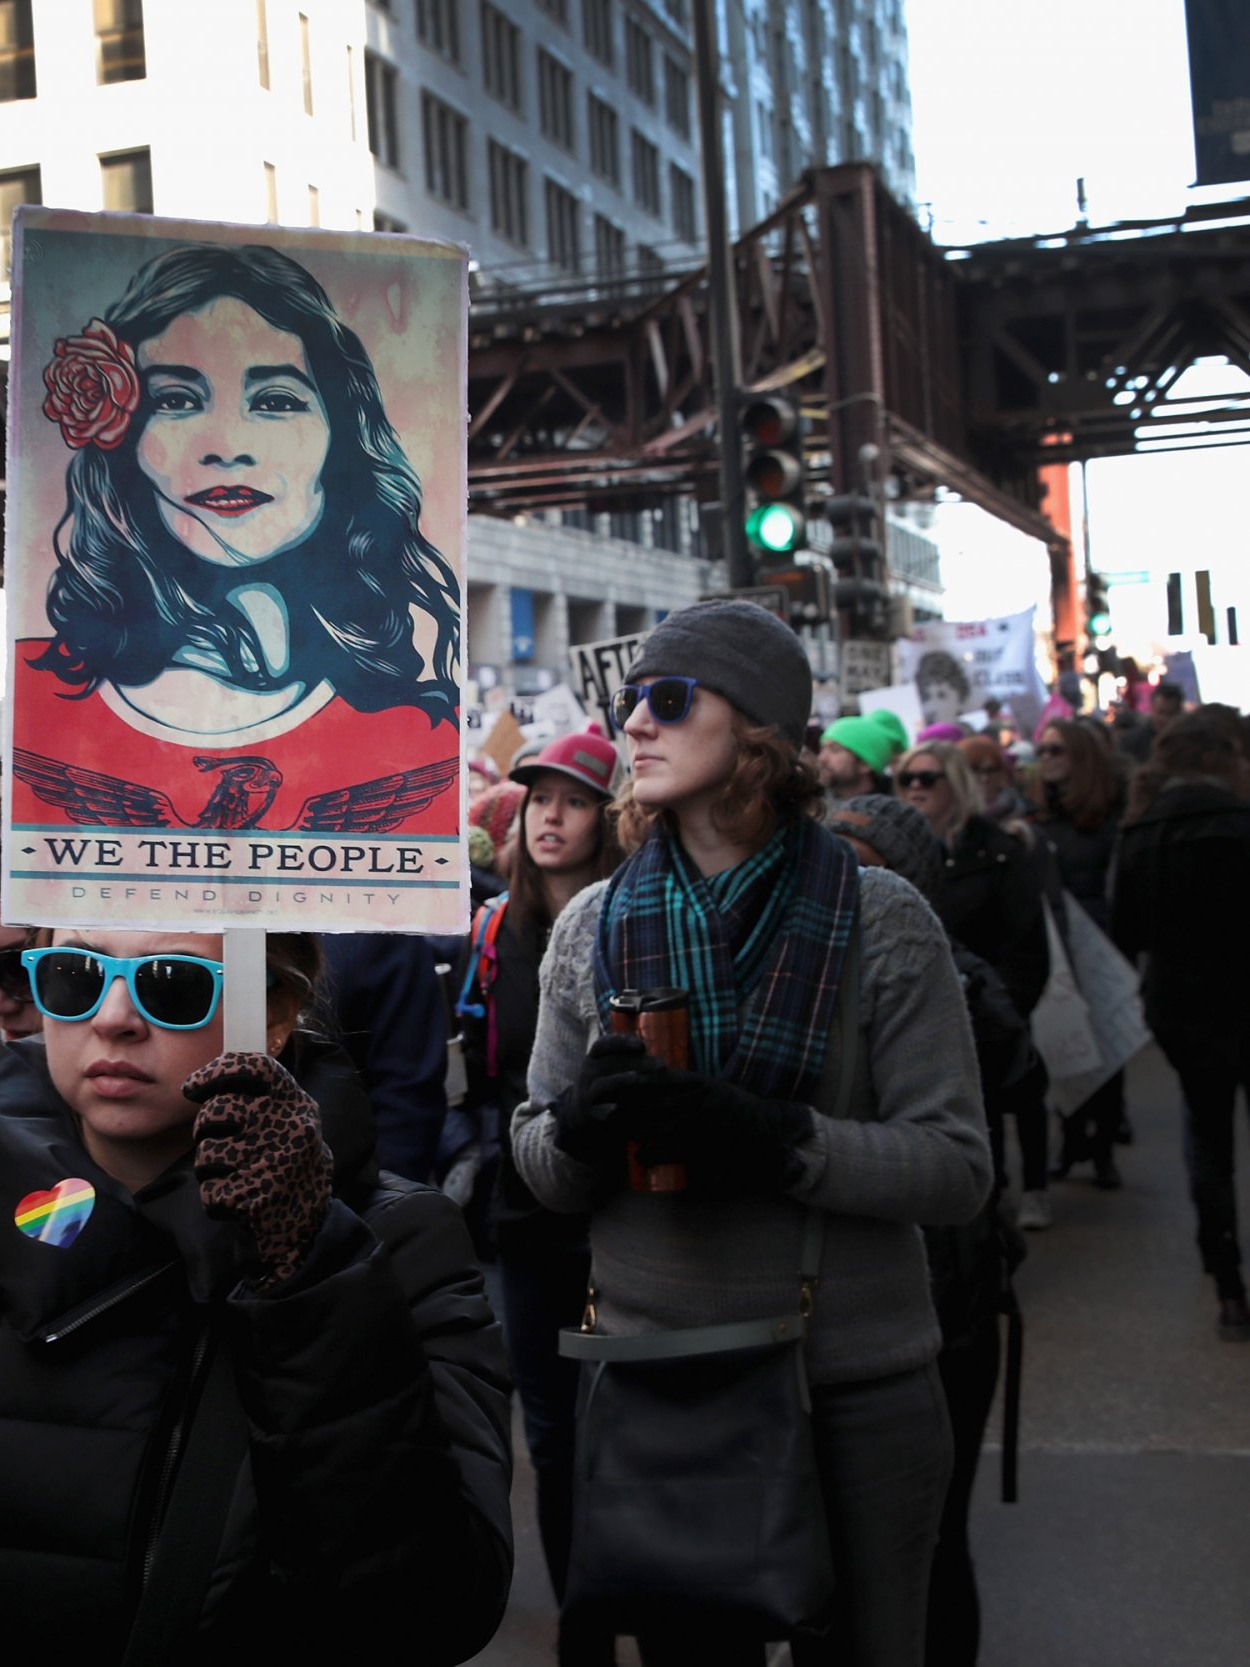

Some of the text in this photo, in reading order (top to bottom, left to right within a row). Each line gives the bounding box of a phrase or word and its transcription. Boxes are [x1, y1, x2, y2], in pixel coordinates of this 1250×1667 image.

[43, 837, 424, 874] WE THE PEOPLE
[72, 886, 400, 905] DEFEND DIGNITY
